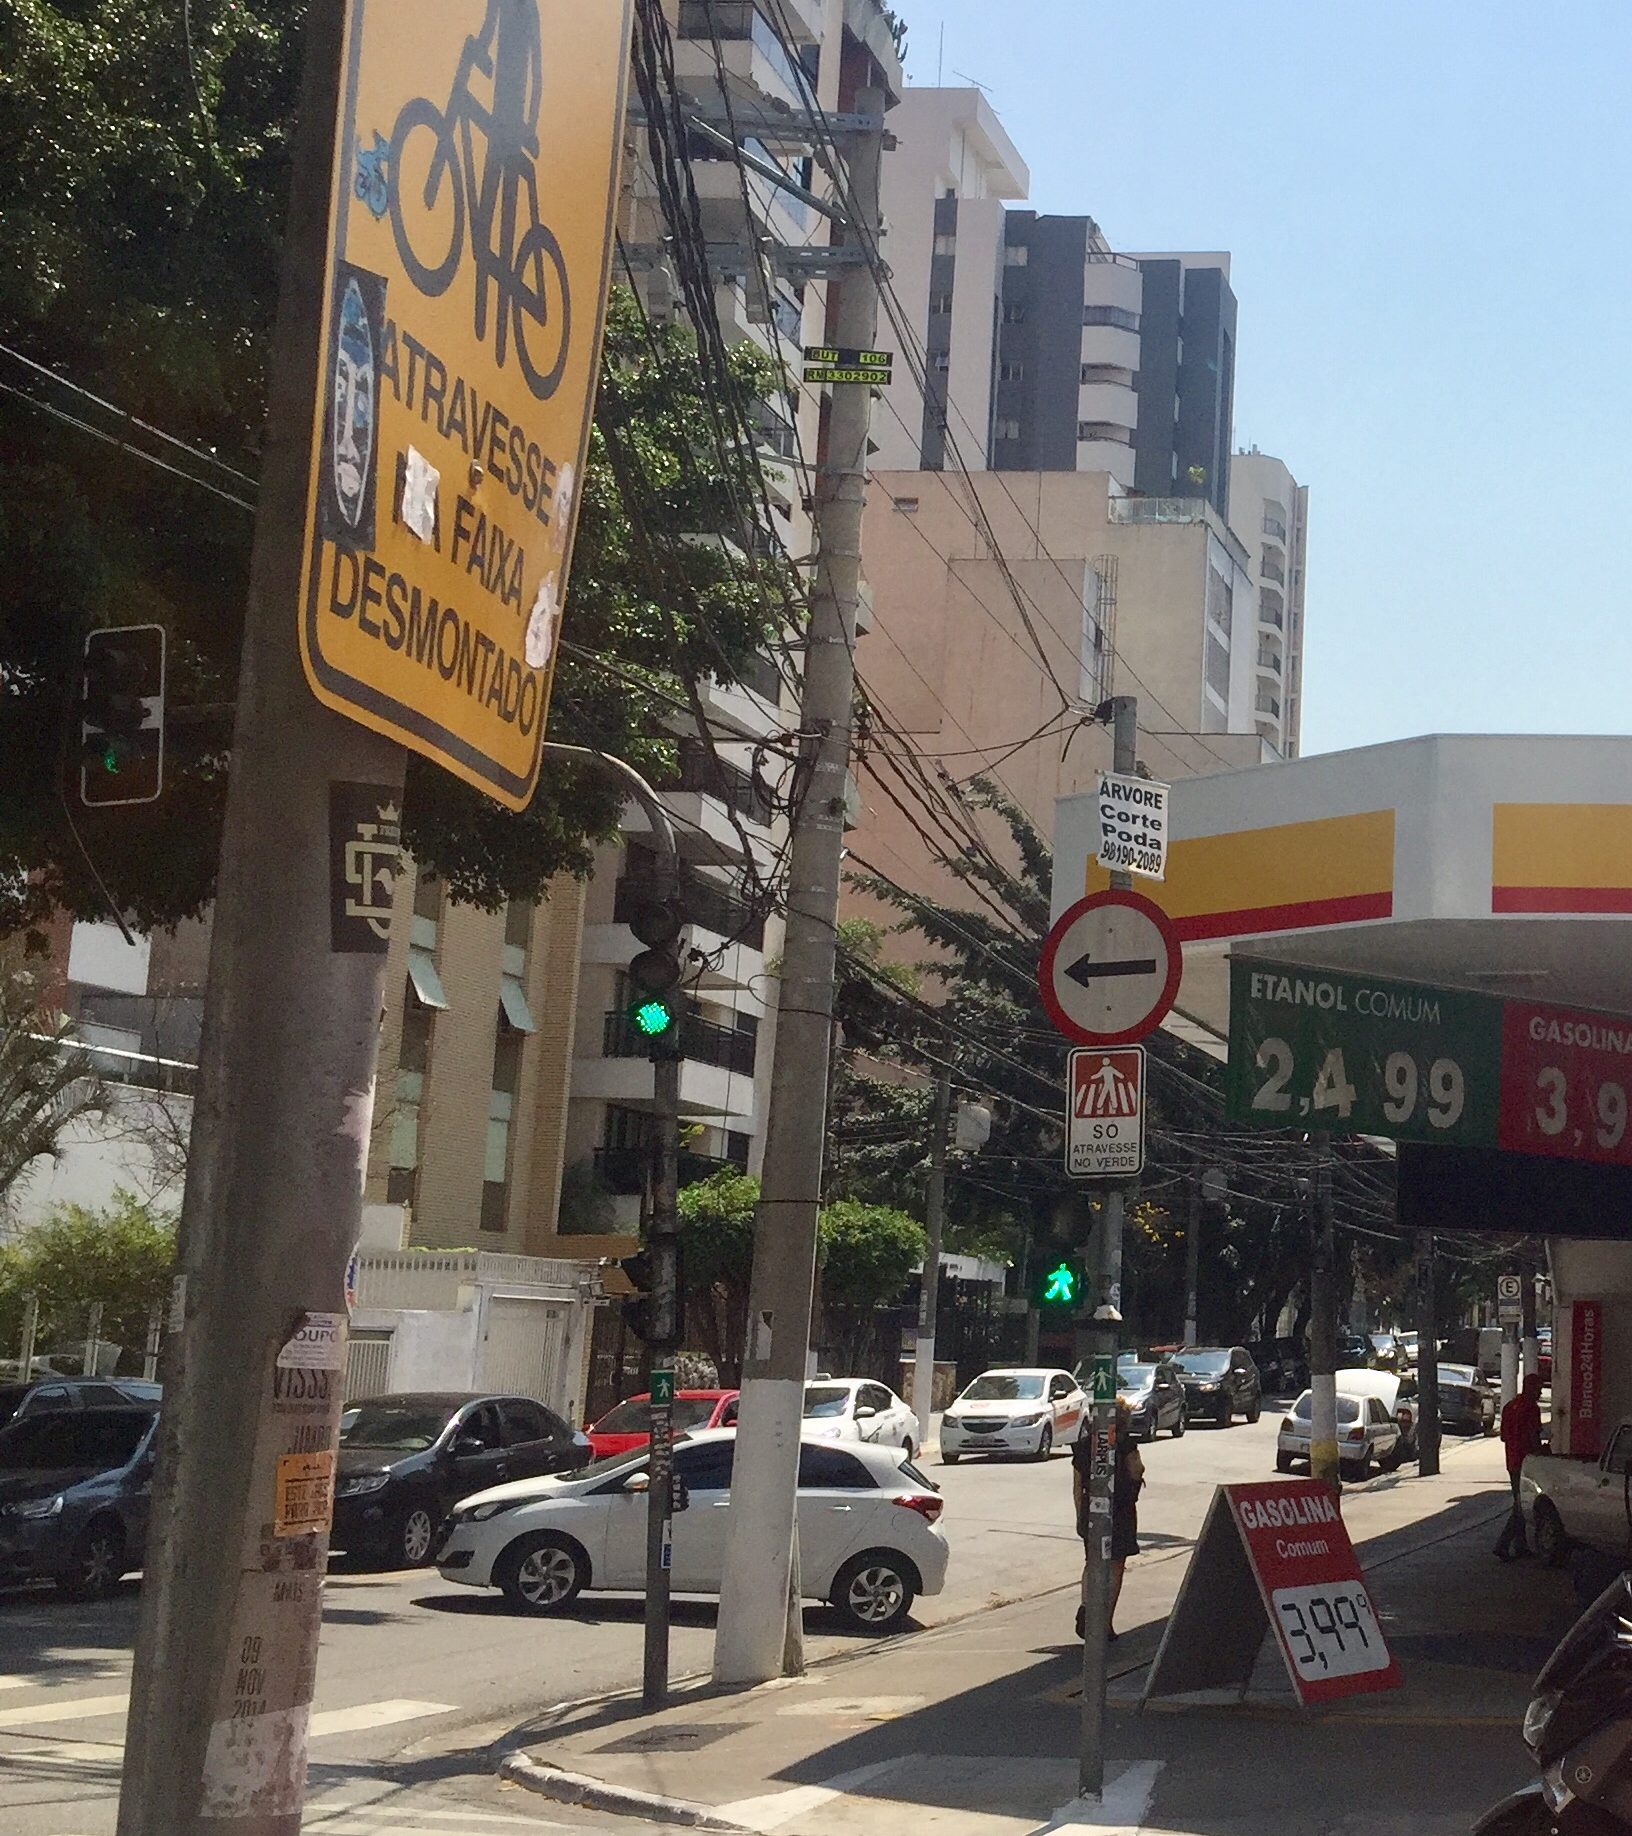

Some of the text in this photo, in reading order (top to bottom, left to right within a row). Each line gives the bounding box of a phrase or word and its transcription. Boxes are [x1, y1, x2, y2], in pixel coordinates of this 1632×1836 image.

[861, 353, 887, 364] 106
[379, 318, 559, 527] ATRAVESSE
[451, 494, 525, 616] FAIXA
[329, 550, 538, 737] DESMONTADO
[1100, 777, 1163, 810] ÁRVORE
[1100, 804, 1162, 831] Corte
[1101, 822, 1162, 851] Poda
[1101, 840, 1162, 874] 98190-2089
[1251, 972, 1441, 1025] ETANOL COMUM
[1073, 1142, 1138, 1154] ATRAVESSE
[1074, 1156, 1136, 1168] NO VERDE
[1240, 1495, 1339, 1529] GASOLINA
[1276, 1538, 1330, 1559] Comum
